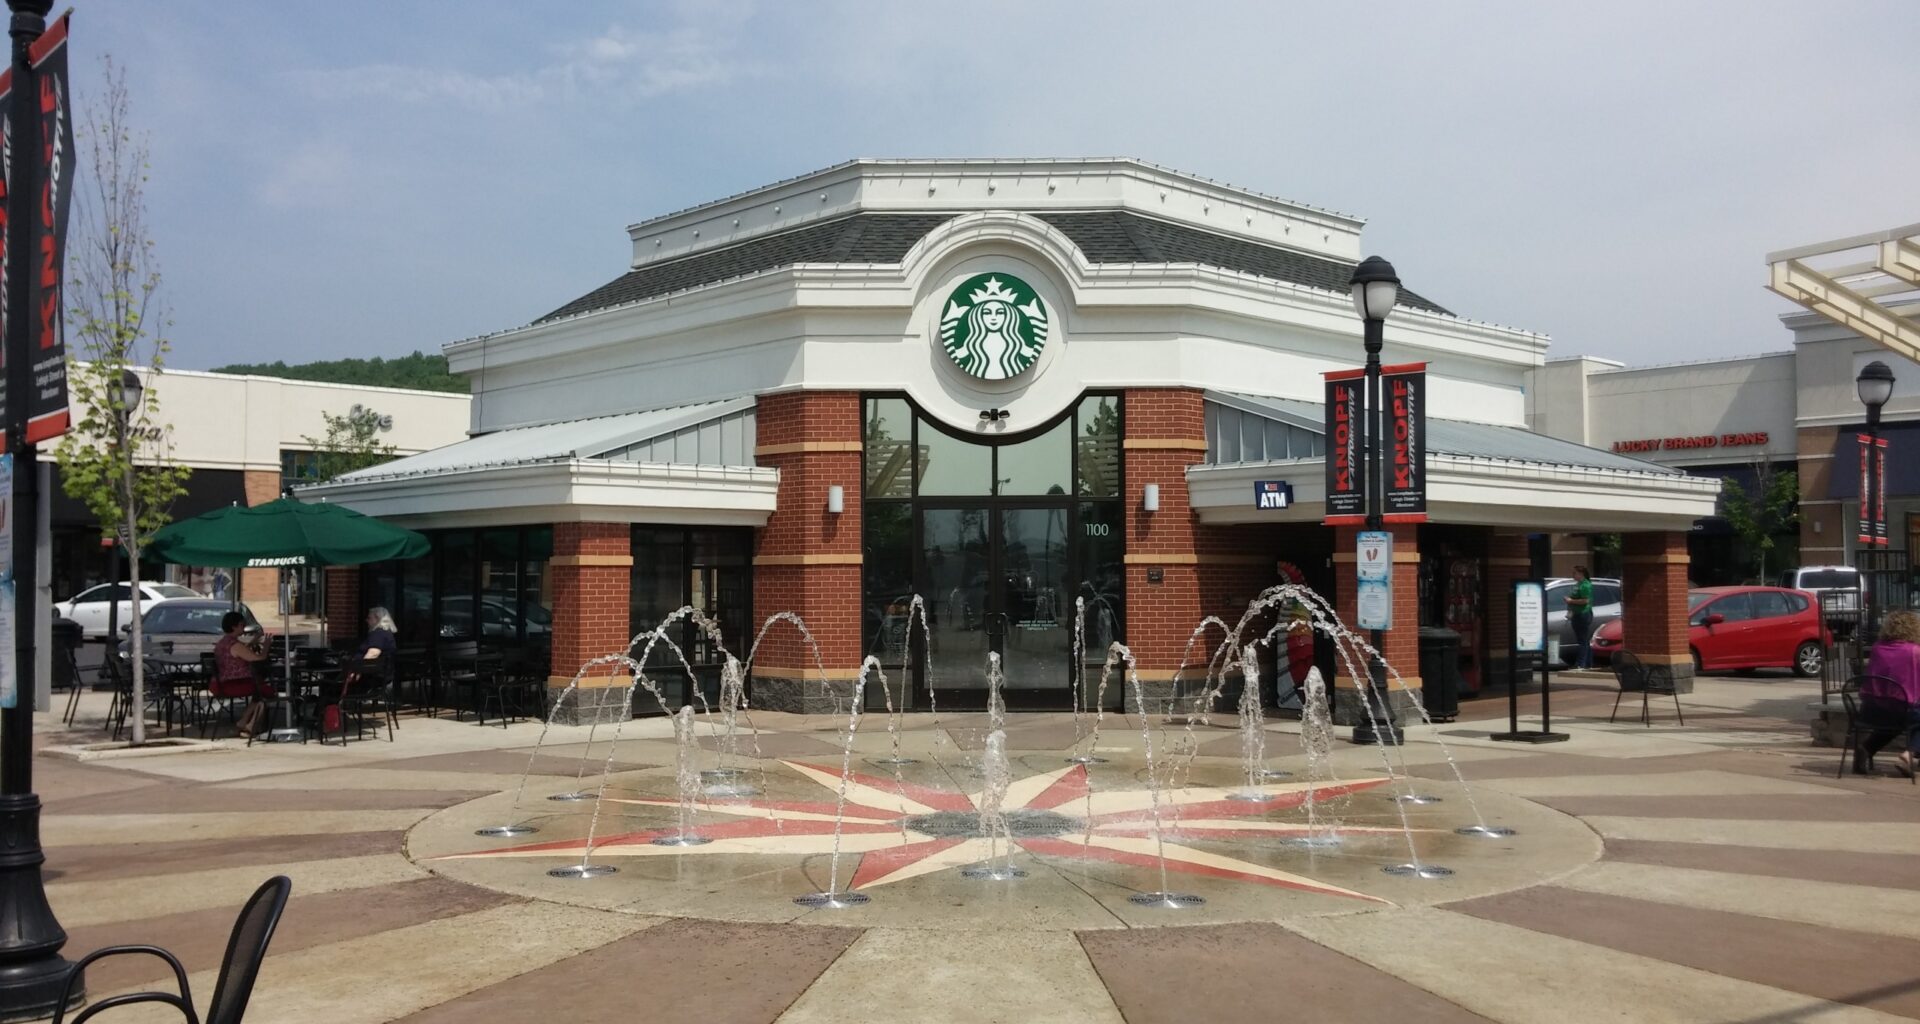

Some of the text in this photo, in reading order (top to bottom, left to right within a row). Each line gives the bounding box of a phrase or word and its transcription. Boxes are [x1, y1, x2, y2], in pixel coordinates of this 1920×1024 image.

[1335, 384, 1349, 491] KNOPF
[1393, 379, 1409, 489] KNOPF
[1407, 381, 1416, 476] AUTOMOTIVE
[1612, 431, 1769, 453] LUCKY BRAND JEANS
[1260, 492, 1287, 508] ATM
[1085, 523, 1109, 536] 1100
[247, 556, 306, 566] STARBUCKS
